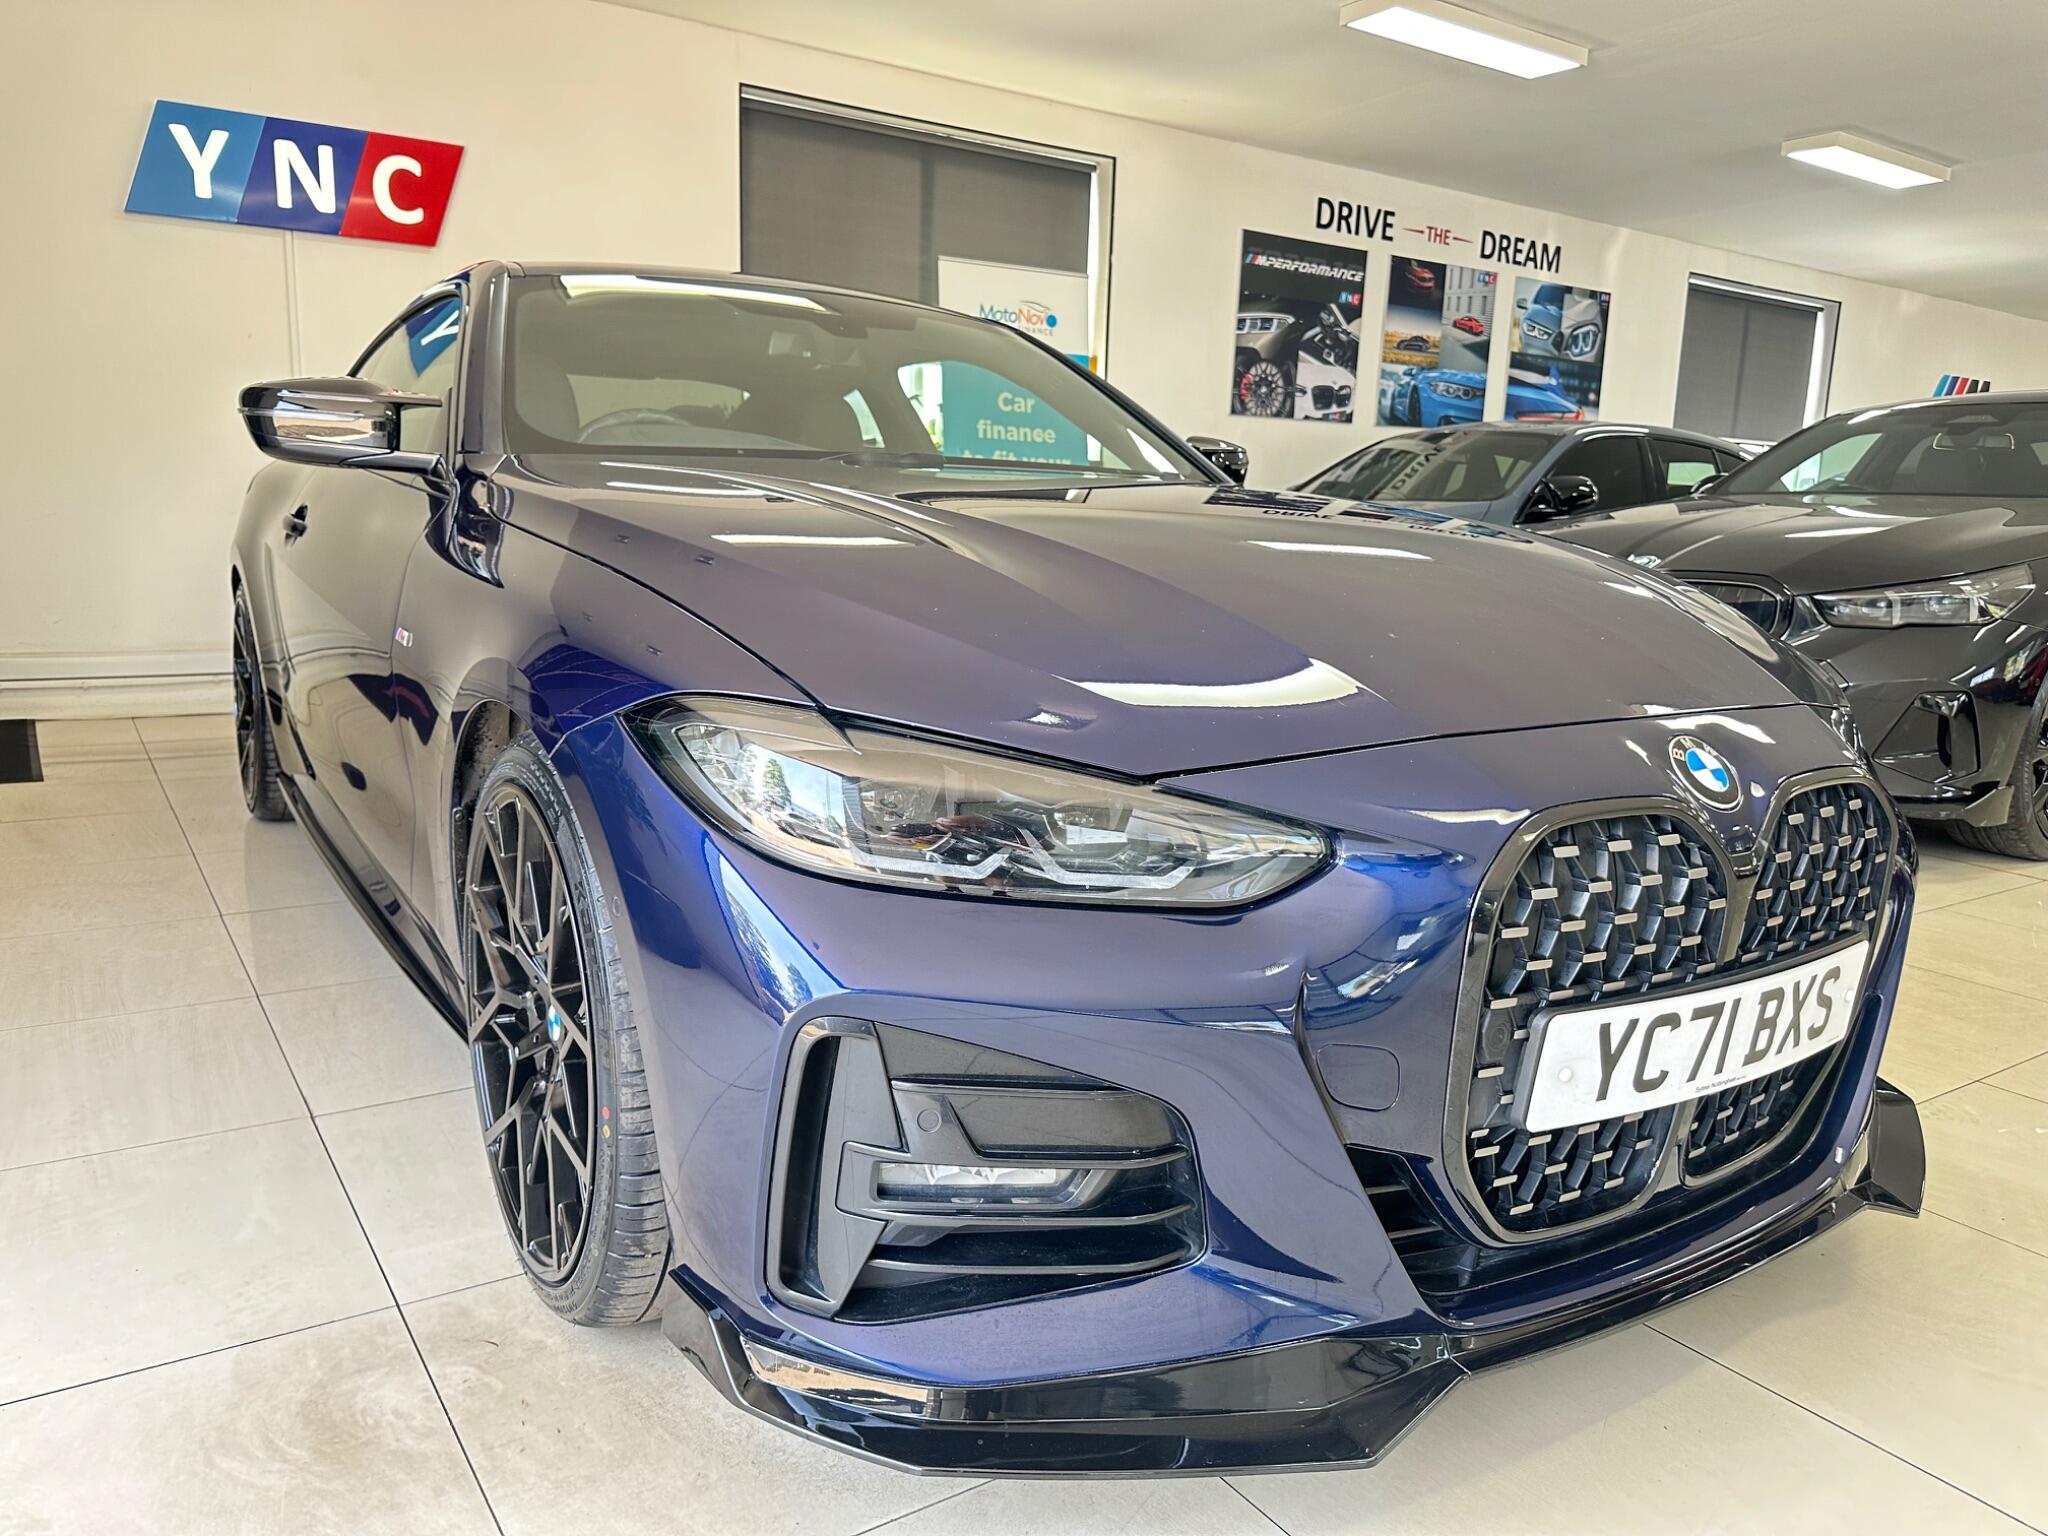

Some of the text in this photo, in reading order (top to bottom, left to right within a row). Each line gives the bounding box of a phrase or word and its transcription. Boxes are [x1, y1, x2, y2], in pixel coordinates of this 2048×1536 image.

[168, 123, 424, 225] YNC
[1315, 197, 1562, 274] DRIVE THE DREAM
[976, 419, 1056, 443] finance
[997, 391, 1036, 414] Car
[1596, 965, 1841, 1101] YC71 BXS
